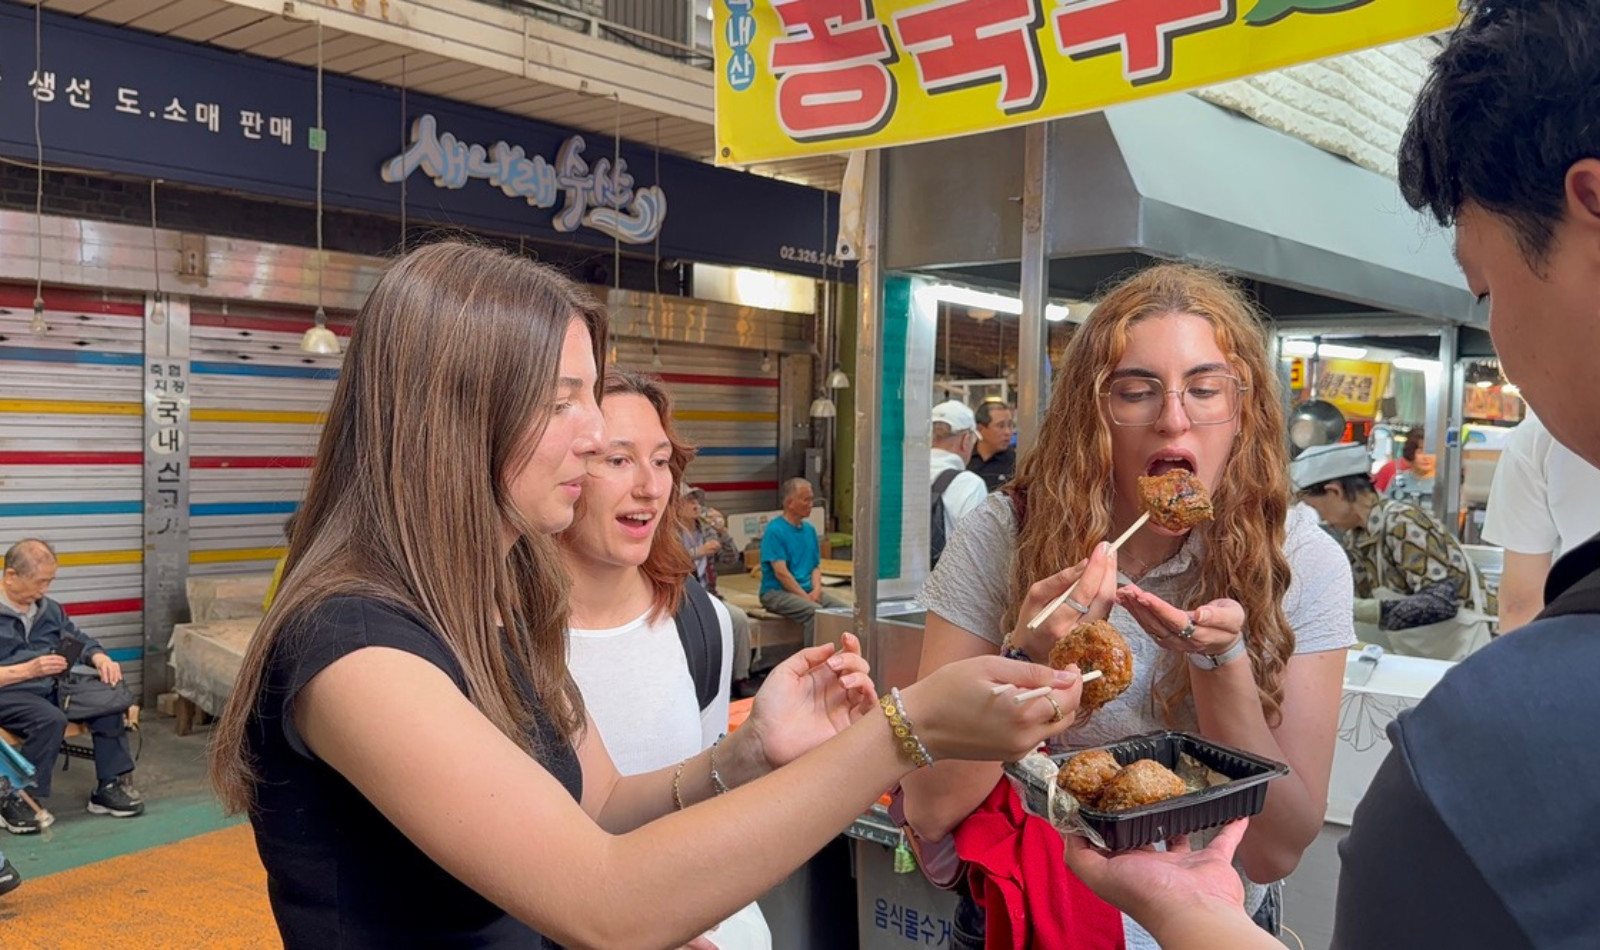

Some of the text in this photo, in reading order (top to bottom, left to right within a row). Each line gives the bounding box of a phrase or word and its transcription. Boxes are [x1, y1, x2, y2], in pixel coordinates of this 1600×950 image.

[728, 0, 751, 85] 내산
[28, 70, 293, 145] 생선 도.소매 판매
[875, 898, 951, 945] 음식물수거
